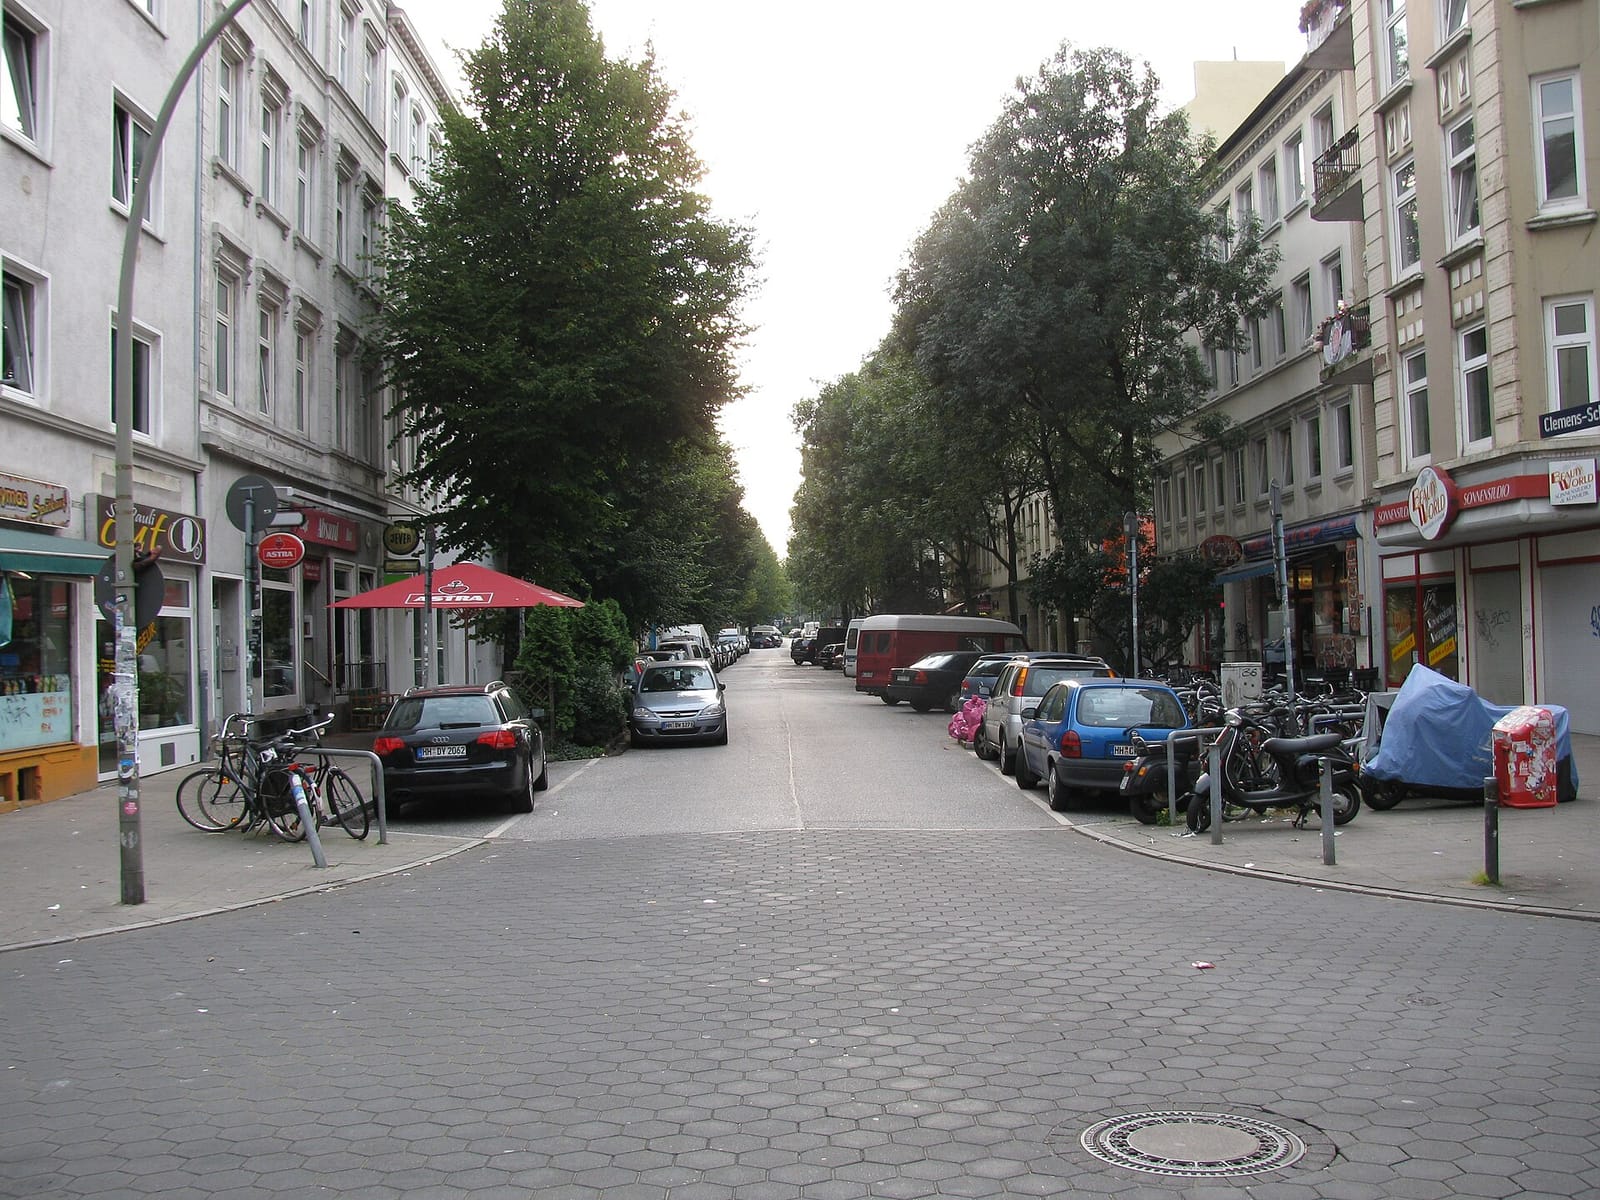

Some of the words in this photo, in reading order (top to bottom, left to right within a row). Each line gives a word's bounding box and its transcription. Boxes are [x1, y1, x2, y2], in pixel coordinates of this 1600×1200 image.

[1559, 474, 1594, 491] WORLD
[1463, 484, 1510, 505] SONNENSTUDIO
[391, 533, 412, 545] JEVER
[266, 549, 294, 558] ASTRA
